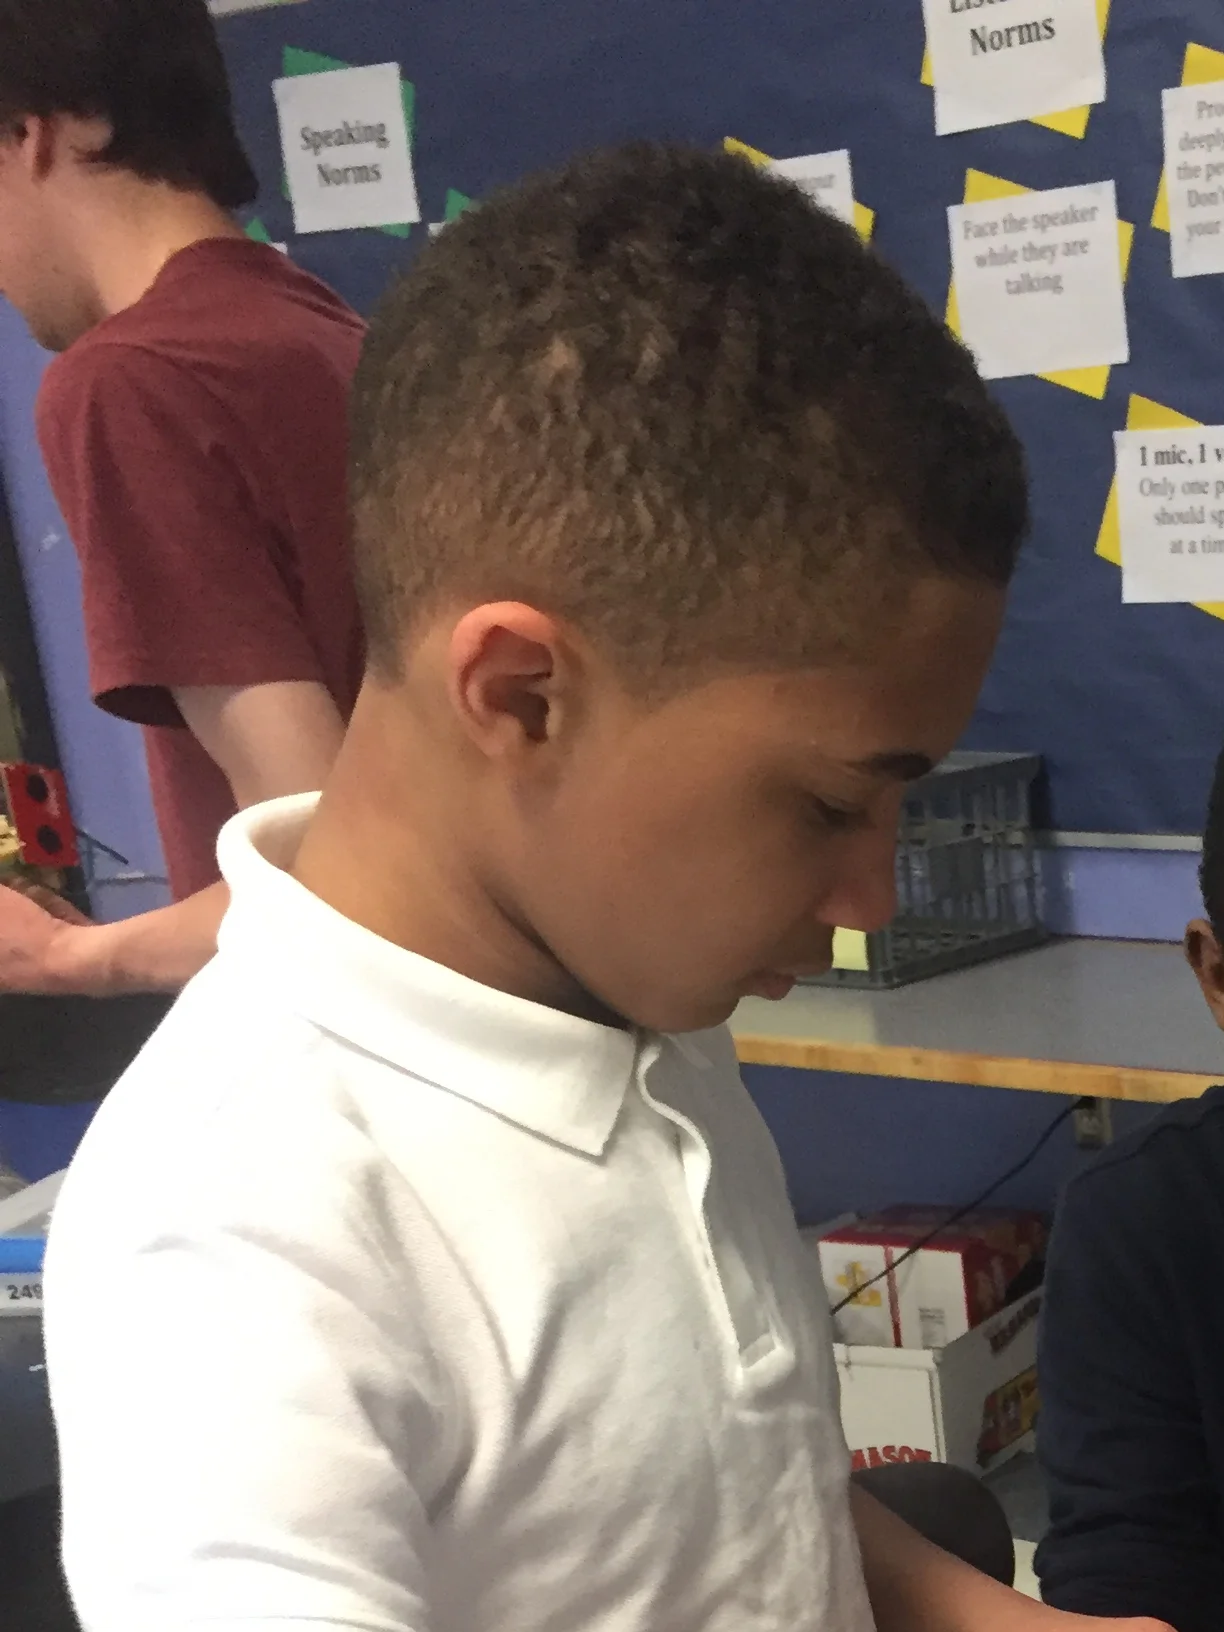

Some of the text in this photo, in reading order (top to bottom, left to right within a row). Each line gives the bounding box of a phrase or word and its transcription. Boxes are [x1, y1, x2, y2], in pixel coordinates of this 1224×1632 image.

[969, 16, 1057, 56] Norms
[301, 120, 390, 156] Speaking
[317, 163, 382, 187] Norms
[1176, 160, 1202, 181] the
[962, 204, 1099, 241] Face the speaker
[1185, 219, 1222, 243] your
[975, 238, 1090, 269] while they are
[1004, 270, 1064, 296] talking
[1139, 445, 1148, 467] 1
[1199, 443, 1207, 464] 1
[1139, 476, 1176, 501] Only
[1181, 479, 1209, 496] one
[1154, 505, 1206, 528] should
[1169, 538, 1184, 554] at
[1187, 540, 1197, 554] a
